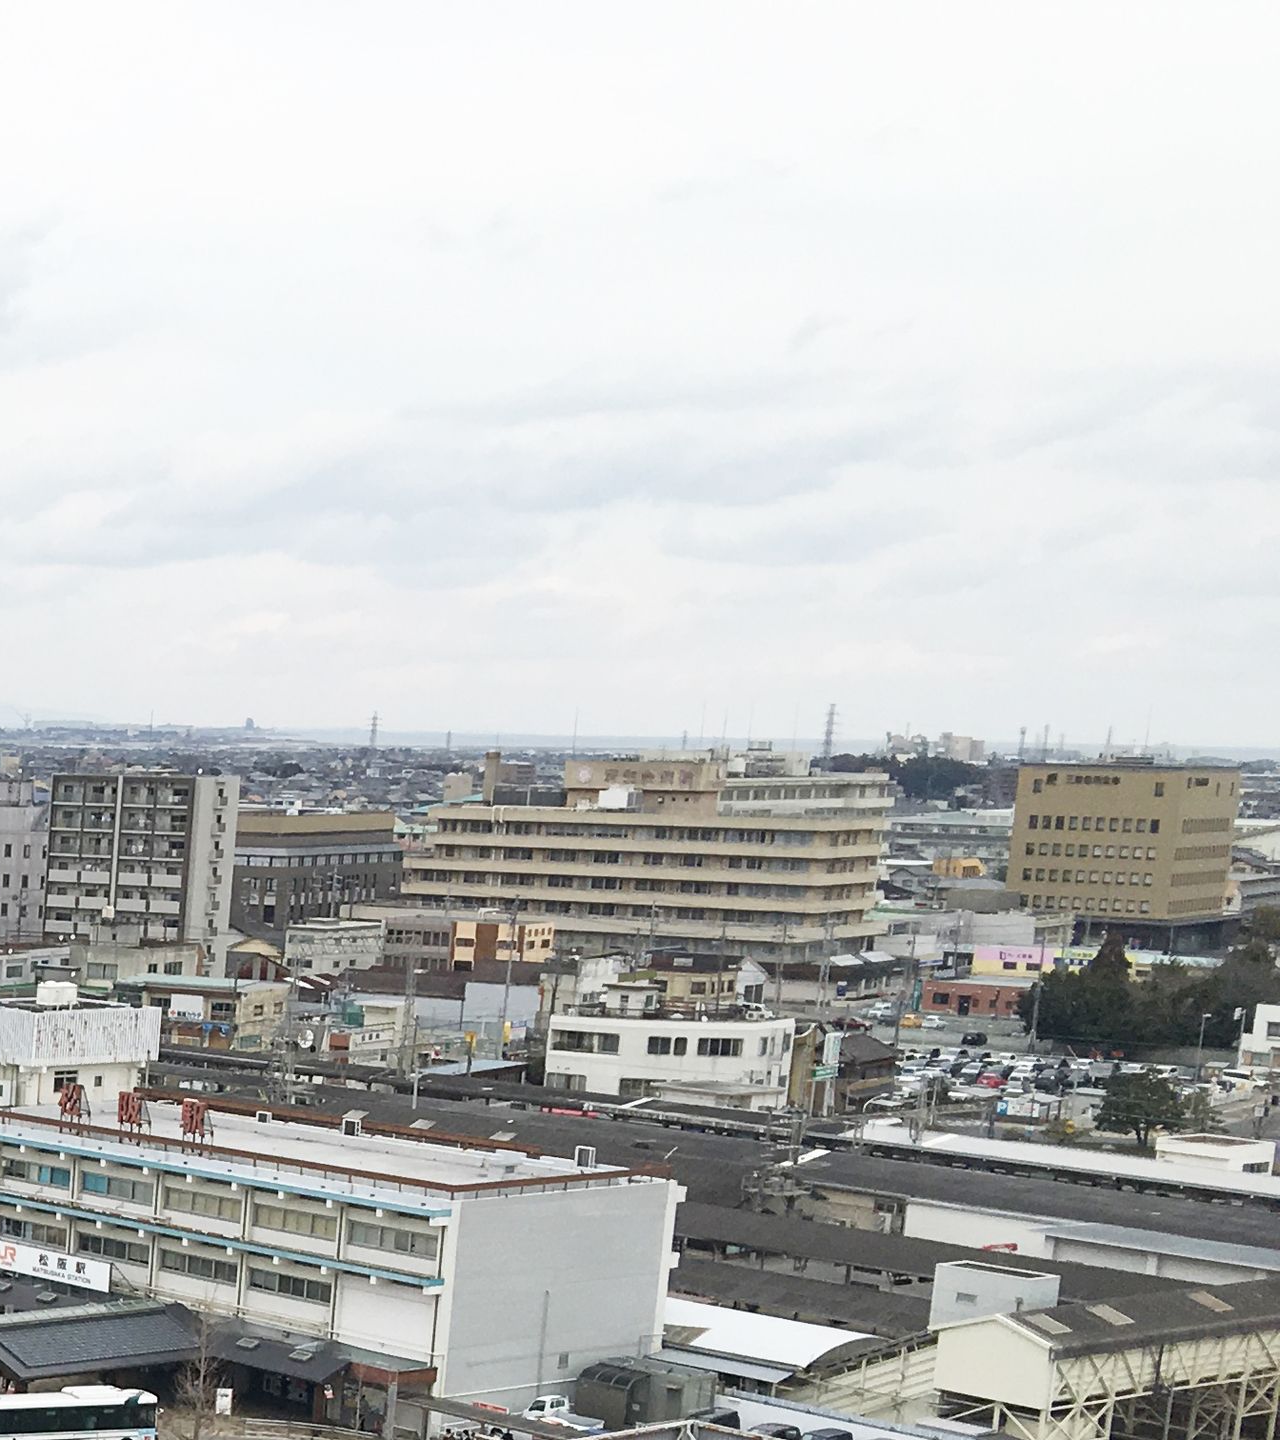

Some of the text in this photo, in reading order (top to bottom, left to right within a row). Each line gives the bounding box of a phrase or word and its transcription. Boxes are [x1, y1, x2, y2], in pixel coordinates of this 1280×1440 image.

[58, 1083, 209, 1137] 松阪駅
[38, 1253, 87, 1275] 松阪駅
